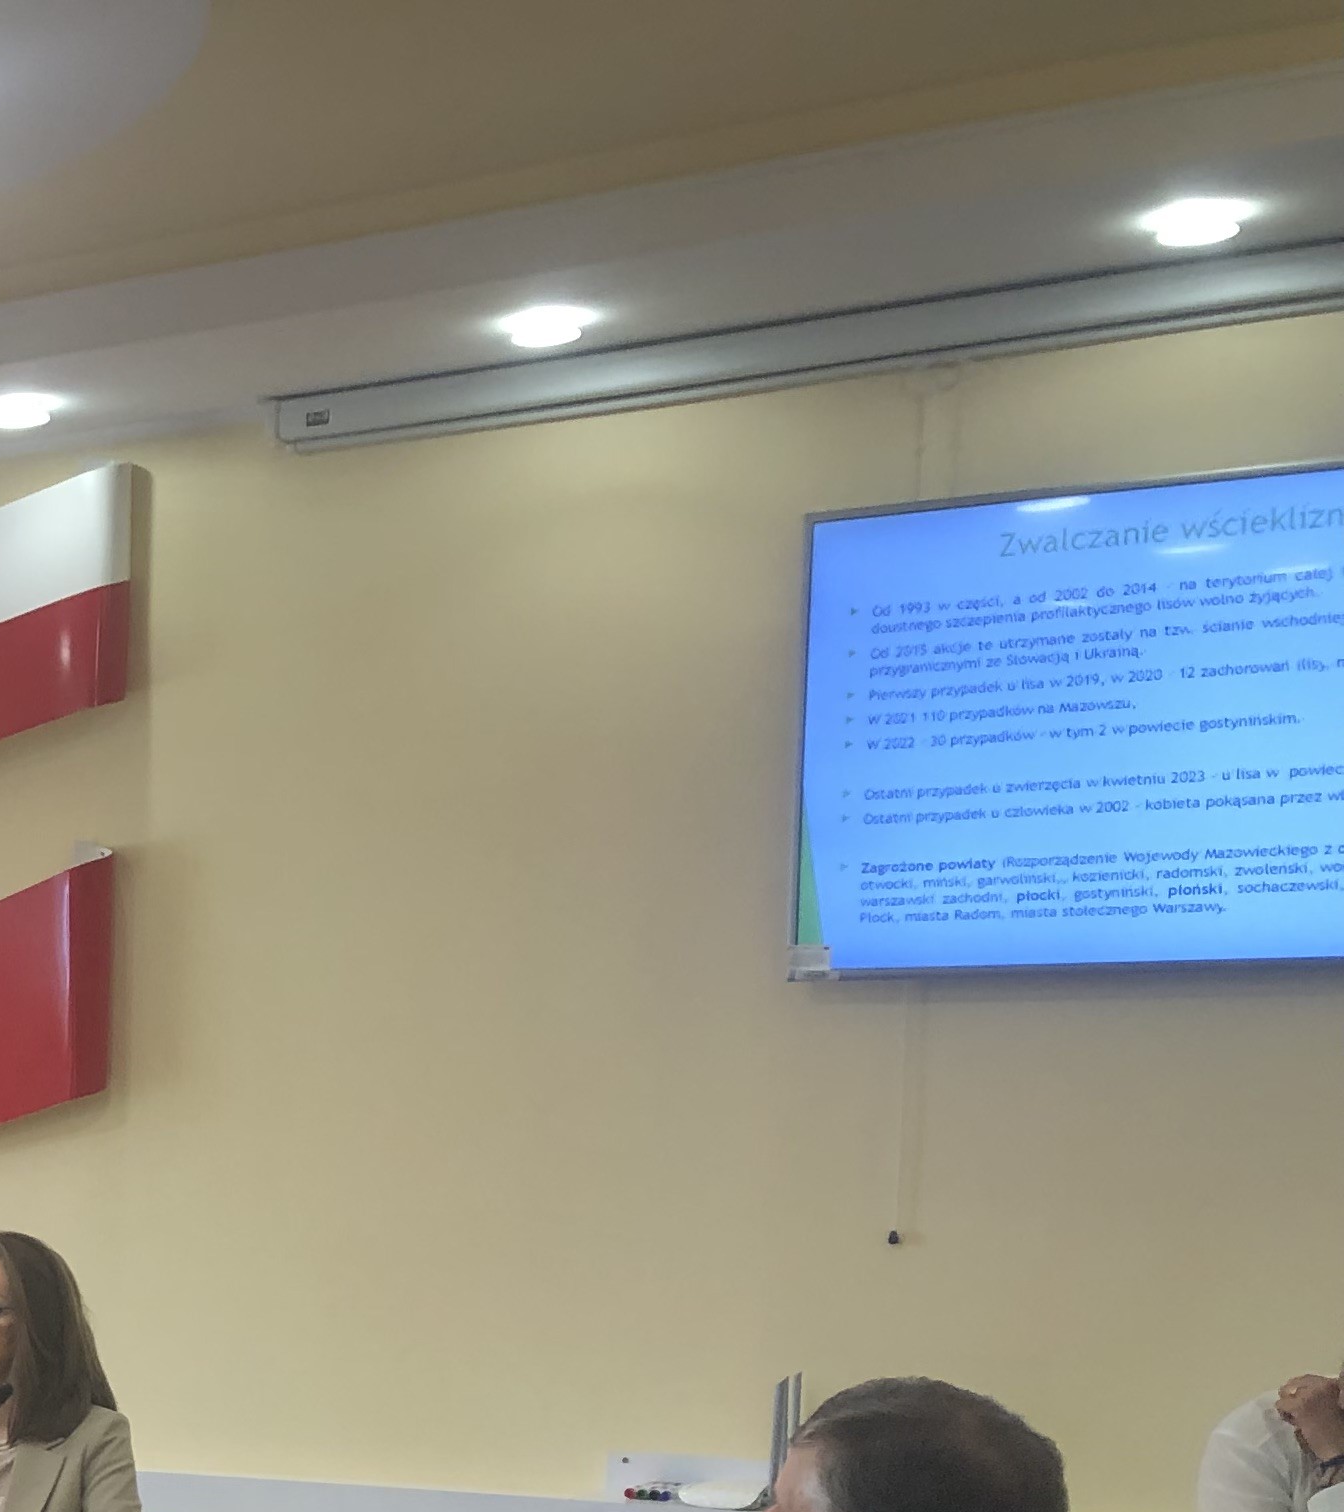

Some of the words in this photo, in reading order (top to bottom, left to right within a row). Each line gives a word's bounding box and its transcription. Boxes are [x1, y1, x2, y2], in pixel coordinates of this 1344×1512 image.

[999, 519, 1168, 556] Zwalczanie
[899, 600, 931, 615] 1993
[1053, 587, 1088, 601] 2002
[1122, 581, 1156, 595] 2014
[1179, 580, 1196, 590] na
[1030, 602, 1152, 624] profilaktycznego
[1199, 594, 1244, 607] wolno
[999, 634, 1075, 649] utrzymane
[1139, 628, 1157, 638] na
[985, 656, 1002, 667] ze
[930, 679, 1003, 698] przypadek
[1049, 678, 1062, 687] w
[1110, 673, 1124, 683] w
[1180, 666, 1195, 678] 12
[1037, 705, 1054, 715] na
[1048, 729, 1062, 738] w
[1066, 726, 1094, 740] tym
[1098, 723, 1106, 735] 2
[1111, 725, 1125, 734] w
[1128, 718, 1194, 737] powiecie
[916, 781, 988, 800] przypadek
[1086, 778, 1099, 788] w
[1102, 772, 1166, 787] kwietniu
[1170, 770, 1205, 783] 2023
[1220, 771, 1231, 781] u
[1235, 767, 1261, 780] lisa
[1265, 769, 1279, 778] w
[915, 806, 986, 825] przypadek
[1078, 804, 1092, 813] w
[1095, 799, 1129, 813] 2002
[1144, 797, 1200, 810] kobieta
[1279, 792, 1322, 806] przez
[861, 859, 933, 875] Zagrożone
[938, 856, 996, 873] powiaty
[1122, 848, 1199, 865] Wojewody
[1204, 844, 1318, 859] Mazowieckiego
[1323, 845, 1332, 855] z
[904, 909, 949, 921] miasta
[1010, 906, 1057, 918] miasta
